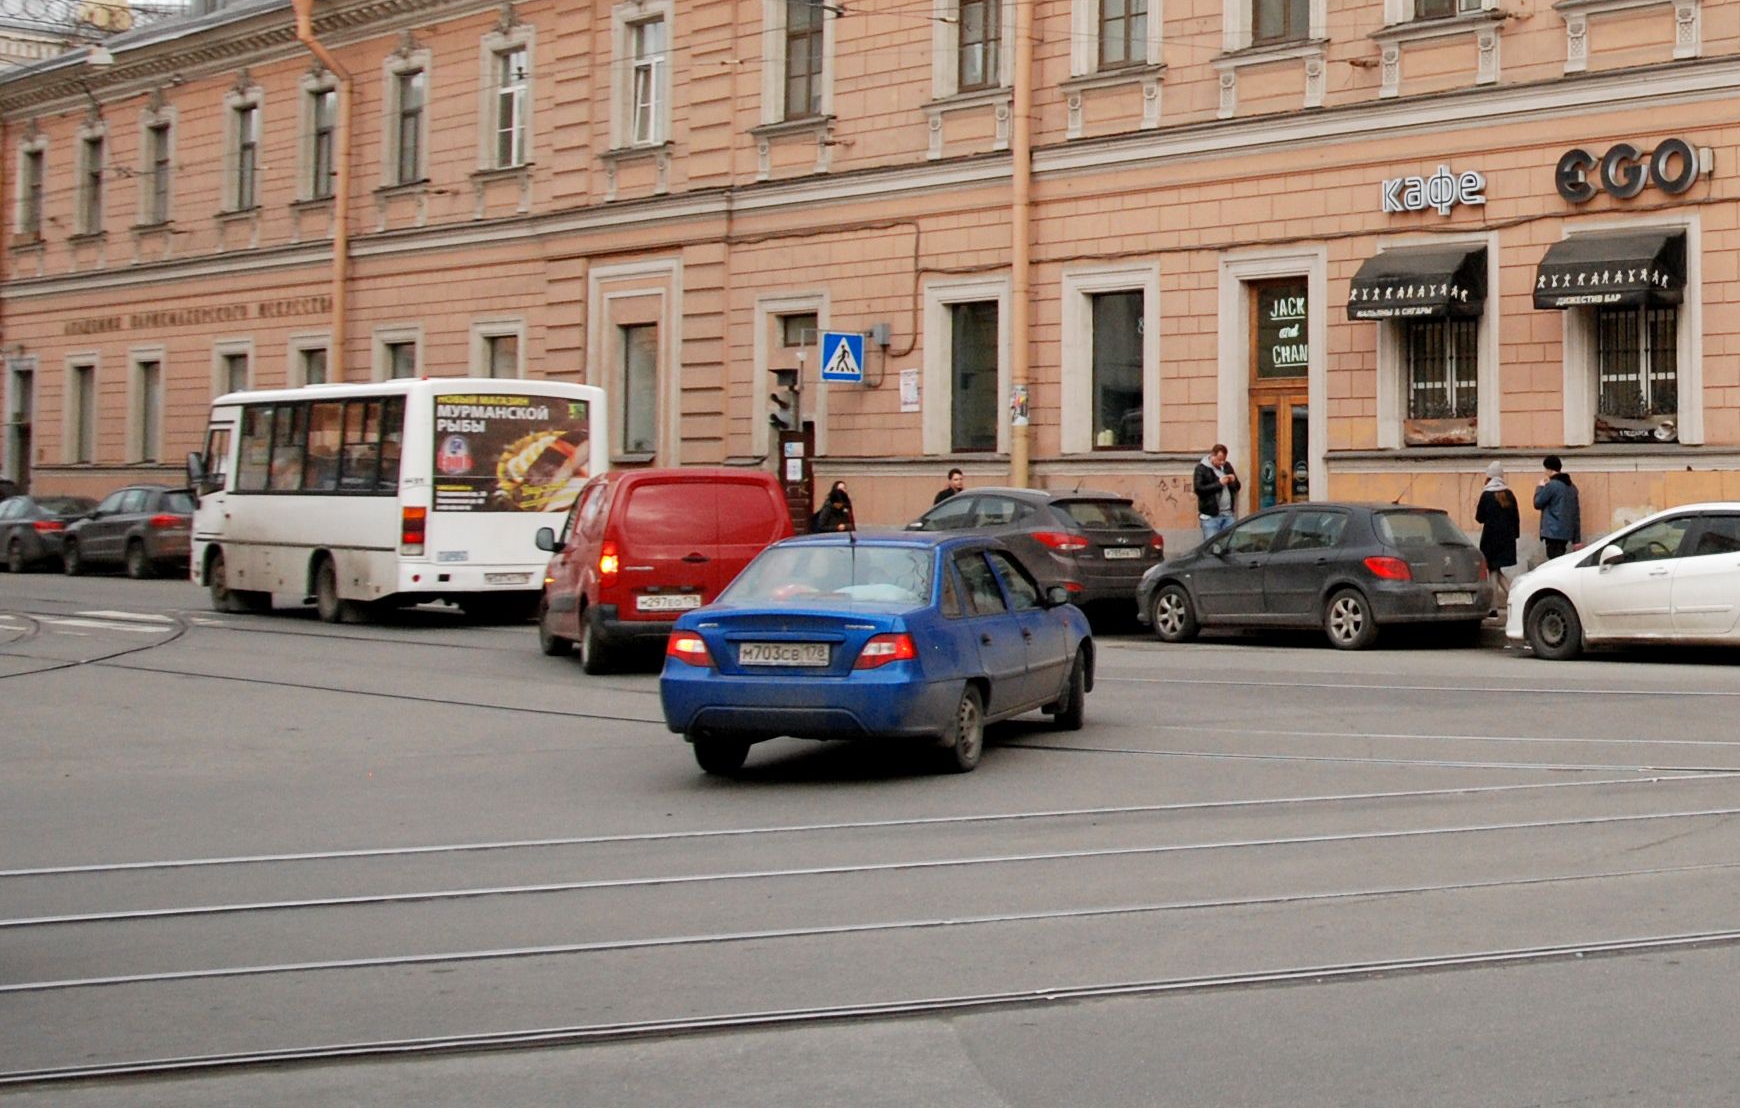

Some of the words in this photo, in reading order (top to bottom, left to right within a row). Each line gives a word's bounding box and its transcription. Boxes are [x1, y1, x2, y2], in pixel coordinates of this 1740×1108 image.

[1555, 138, 1700, 204] EGO
[1382, 164, 1487, 218] кафе
[1604, 293, 1621, 303] БАР
[1270, 297, 1305, 318] JACK
[1278, 323, 1300, 339] and
[1272, 344, 1308, 364] CHAN
[437, 404, 549, 420] МУРМАНСКОЙ
[437, 419, 486, 432] РЫБЫ
